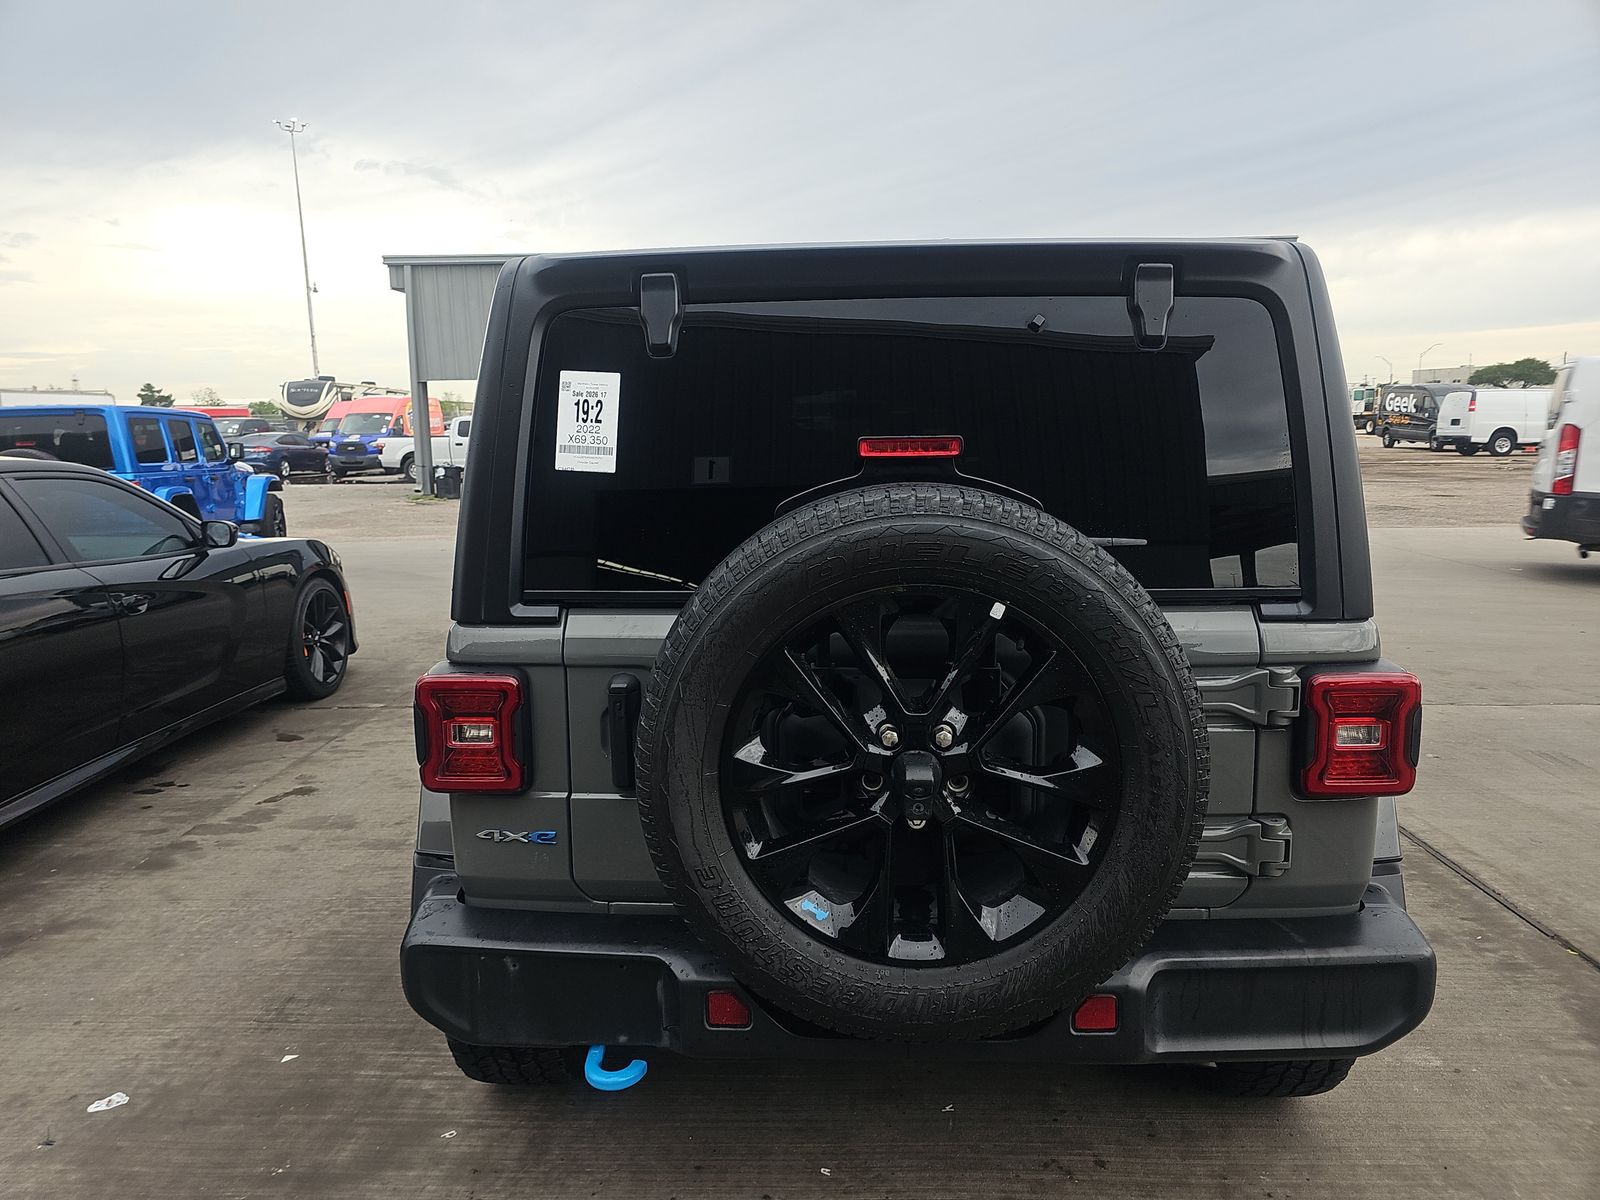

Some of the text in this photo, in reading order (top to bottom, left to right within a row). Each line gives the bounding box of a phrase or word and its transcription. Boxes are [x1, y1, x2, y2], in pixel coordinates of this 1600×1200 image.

[572, 390, 584, 398] Sale
[585, 390, 599, 398] 2026
[1386, 393, 1417, 412] Geek
[574, 399, 603, 424] 19:2
[576, 425, 601, 434] 2022
[804, 540, 1078, 604] DUELER
